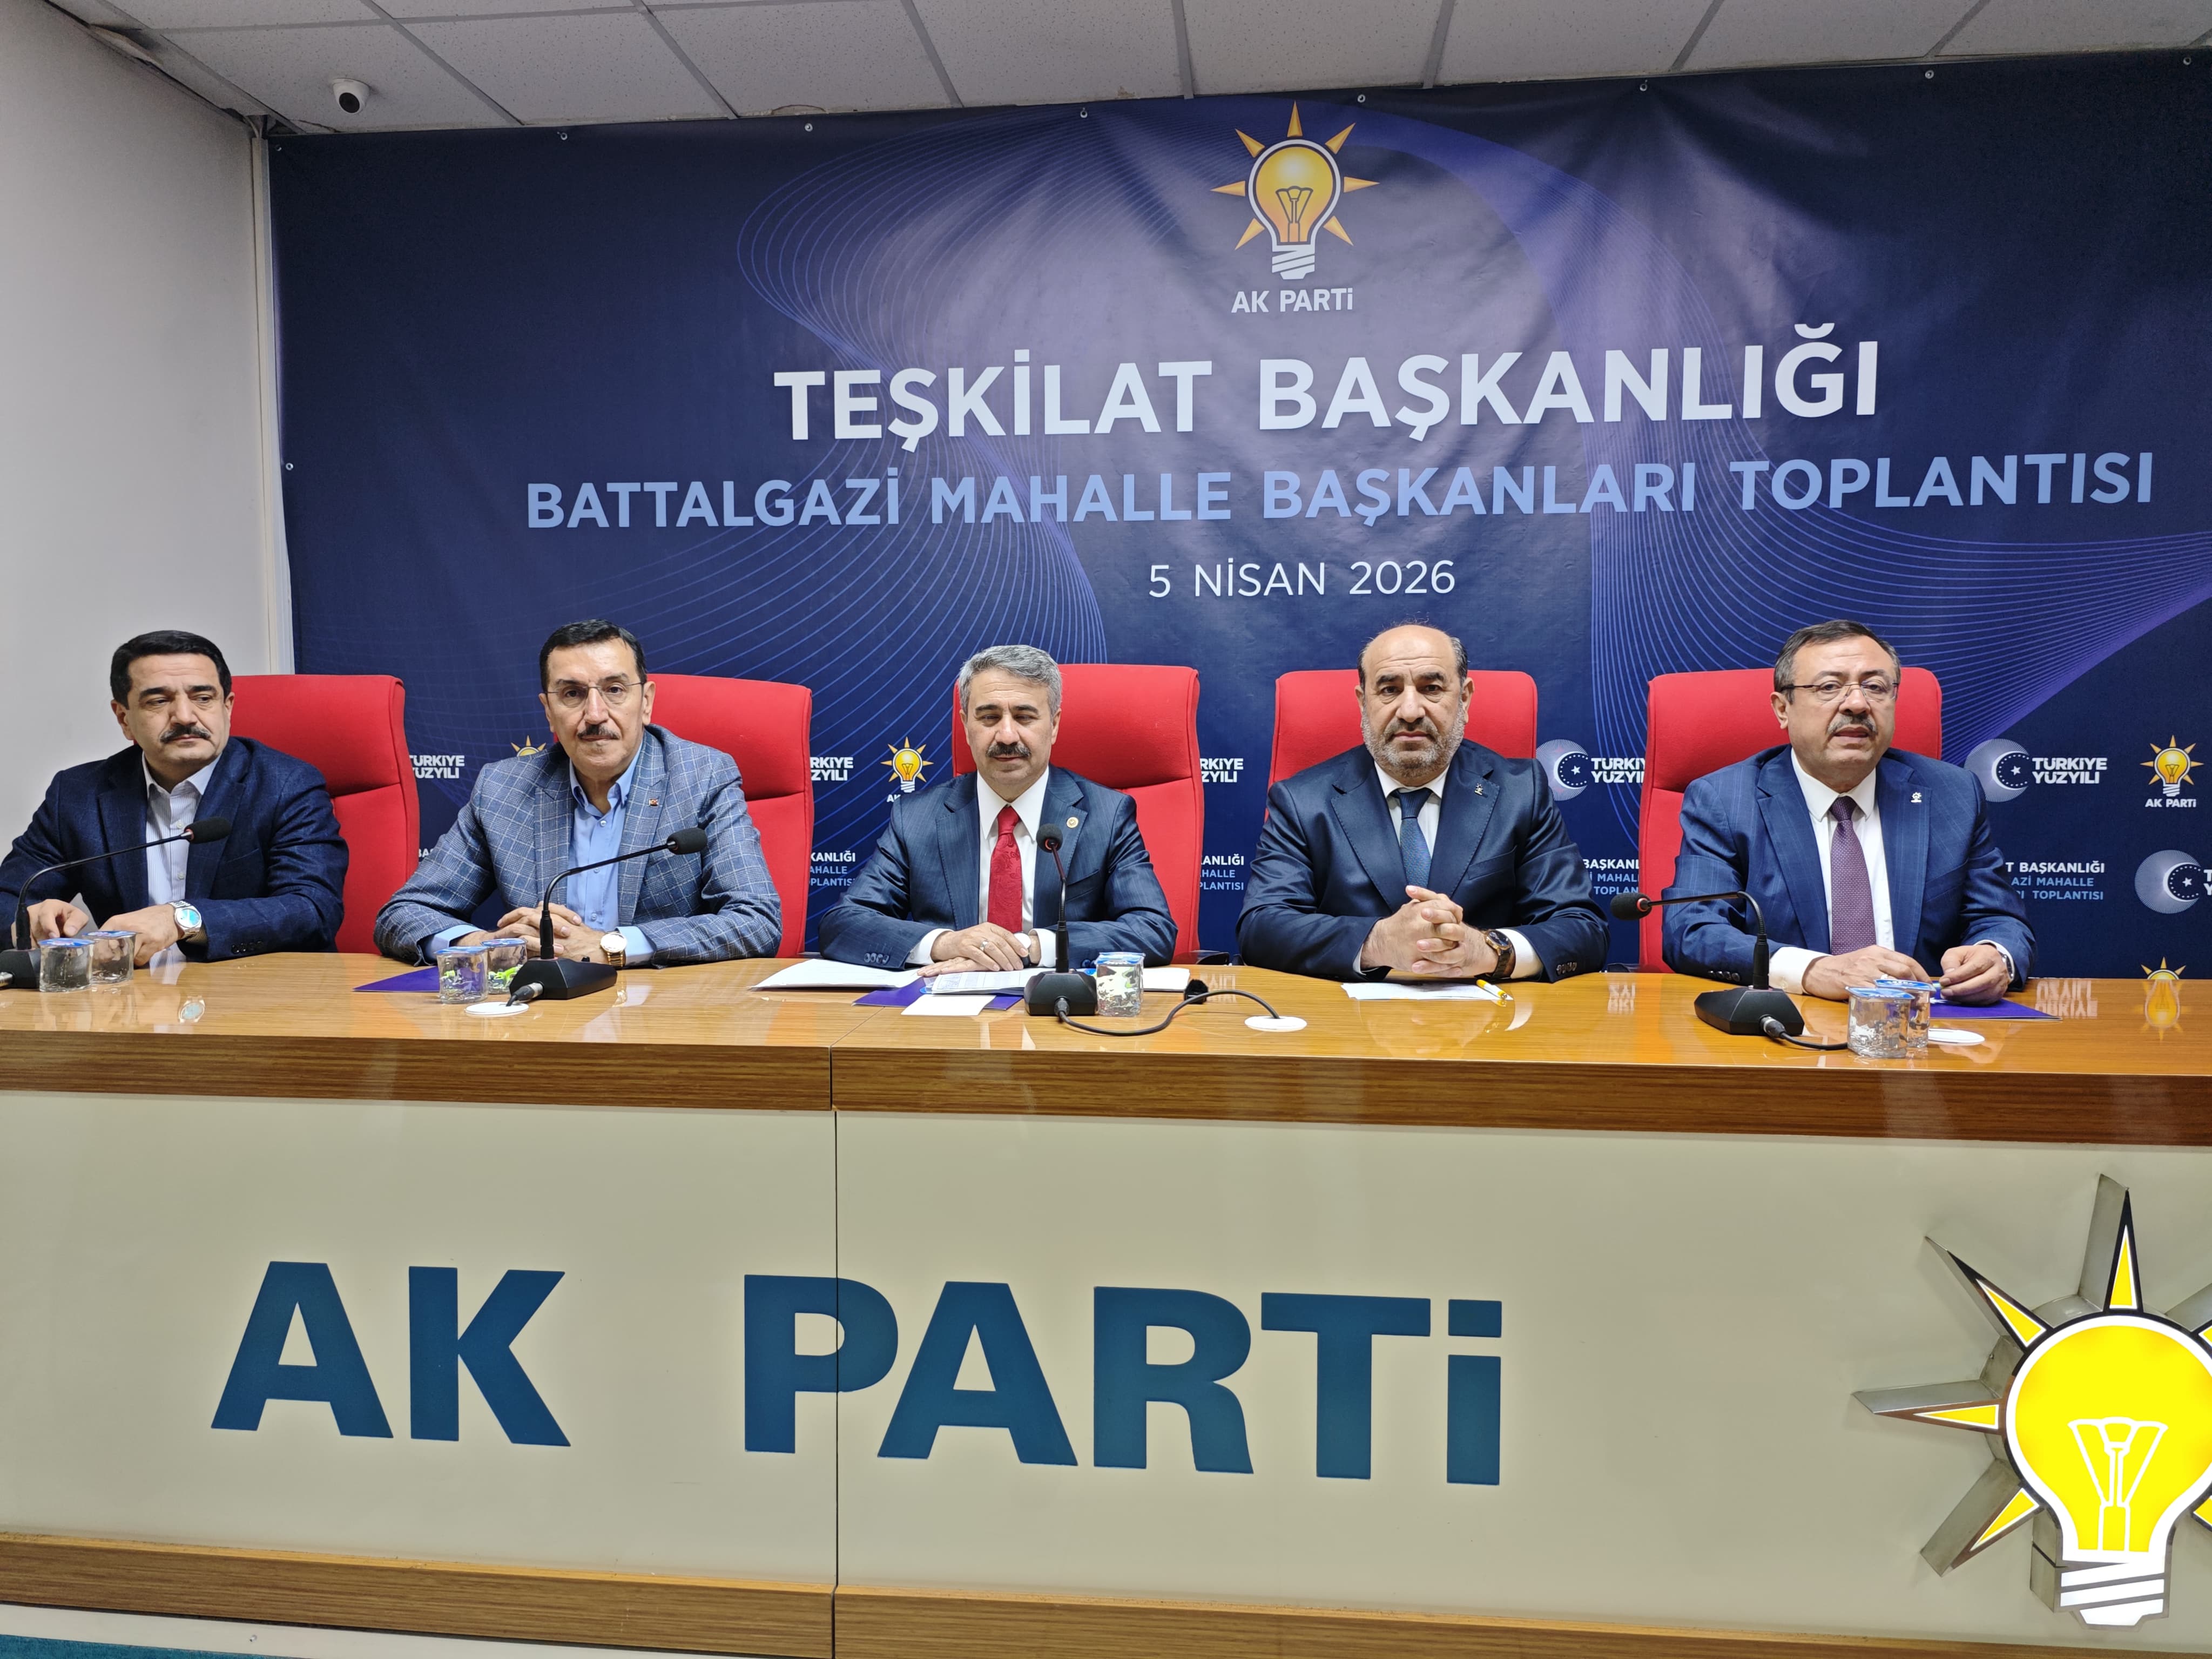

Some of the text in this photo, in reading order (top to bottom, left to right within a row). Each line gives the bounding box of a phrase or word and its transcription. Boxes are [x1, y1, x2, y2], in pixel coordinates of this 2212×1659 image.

[1231, 291, 1270, 313] AK
[774, 322, 1878, 453] TEŞKİLAT BAŞKANLIĞI
[527, 452, 2153, 528] BATTALGAZİ MAHALLE BAŞKANLARI TOPLANTISI
[1149, 558, 1455, 598] 5 NİSAN 2026
[811, 769, 848, 781] ZYILI
[1201, 771, 1237, 783] ZYILI
[2144, 799, 2162, 807] AK
[811, 850, 856, 862] KANLIĞI
[810, 866, 847, 874] AHALLE
[1582, 859, 1639, 871] BAŞKANL
[2019, 860, 2105, 874] BAŞKANLIĞI
[2036, 877, 2094, 886] MAHALLE
[2032, 890, 2103, 900] TOPLANTISI
[211, 1261, 571, 1447] AK
